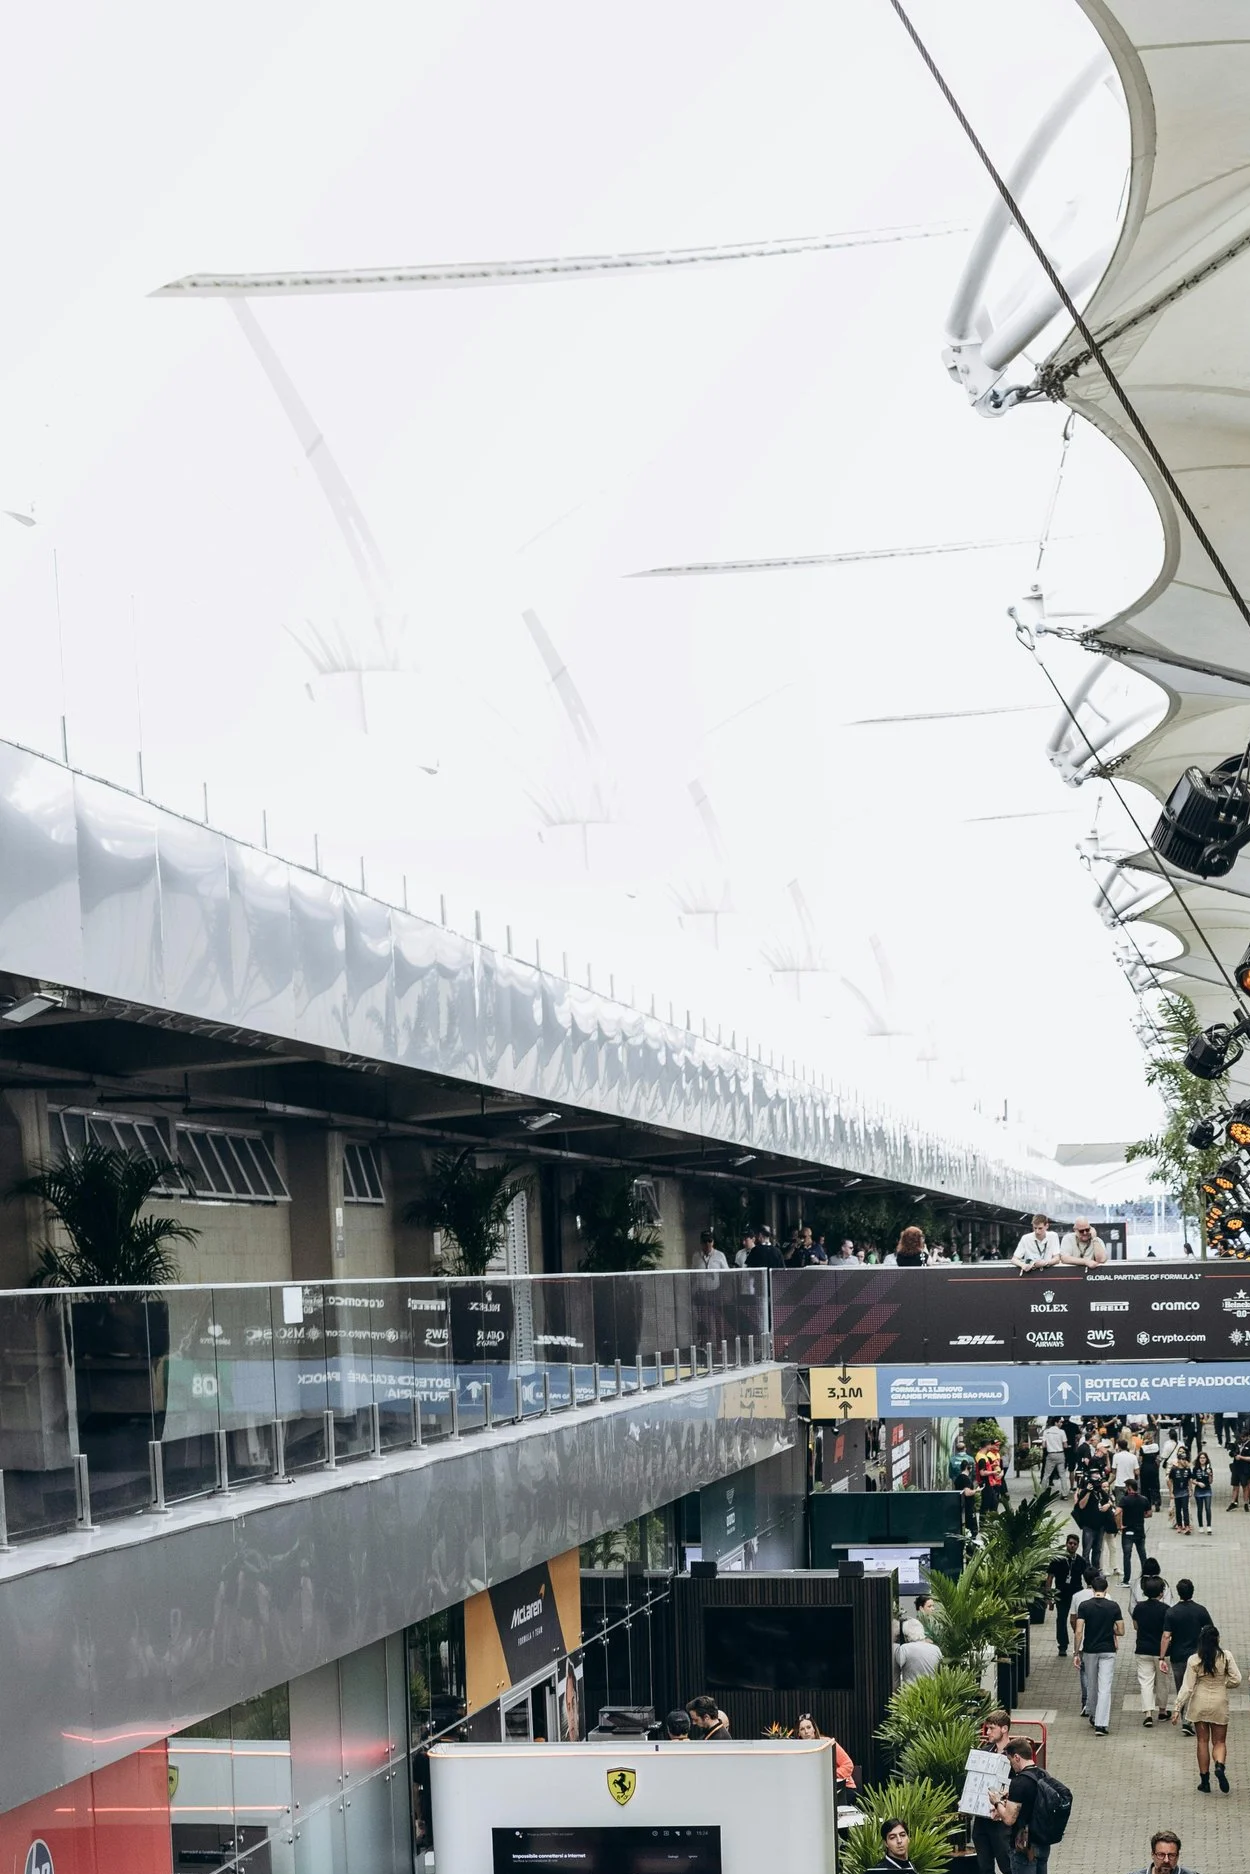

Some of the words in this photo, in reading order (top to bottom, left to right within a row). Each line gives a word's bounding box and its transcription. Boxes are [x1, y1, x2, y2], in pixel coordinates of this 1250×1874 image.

[1030, 1303, 1068, 1313] ROLEX
[1090, 1301, 1129, 1312] PIRELLI
[1151, 1301, 1200, 1311] aramco
[1026, 1331, 1064, 1342] QATAR
[1087, 1329, 1114, 1340] aws
[1151, 1333, 1206, 1344] crypto.com
[1035, 1339, 1065, 1348] AIRWAYS
[1085, 1378, 1137, 1389] BOTECO
[1139, 1377, 1150, 1388] &
[1151, 1374, 1187, 1387] CAFÉ
[1187, 1375, 1250, 1388] PADDOCK
[827, 1386, 863, 1400] 3,1M
[1085, 1391, 1150, 1402] FRUTARIA
[510, 1598, 543, 1630] McLaren
